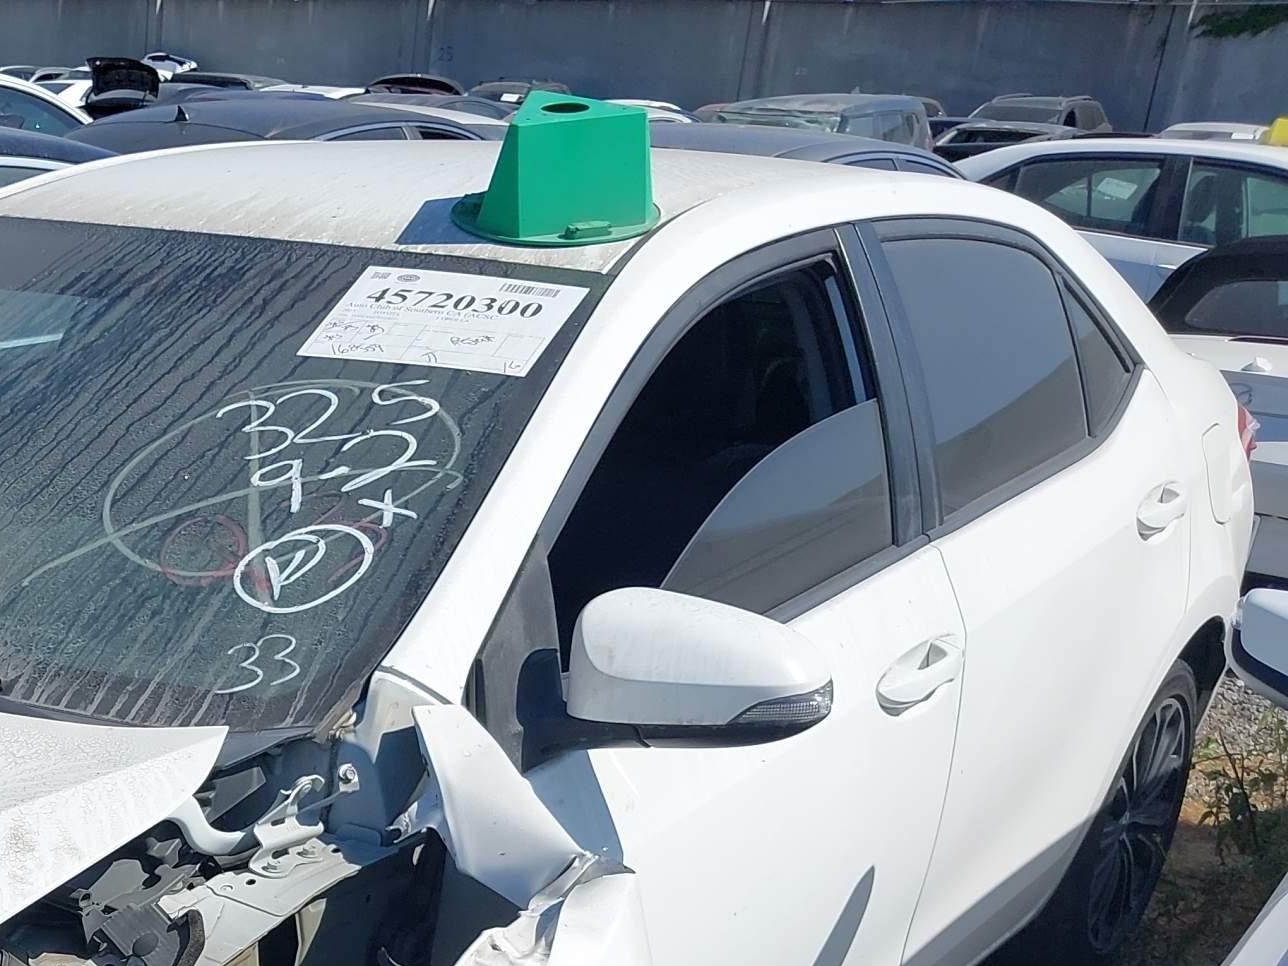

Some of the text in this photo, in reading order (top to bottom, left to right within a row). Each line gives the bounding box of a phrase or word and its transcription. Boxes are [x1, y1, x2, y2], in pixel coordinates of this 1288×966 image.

[365, 287, 544, 319] 45720300
[215, 379, 441, 461] 325
[213, 633, 301, 694] 33
